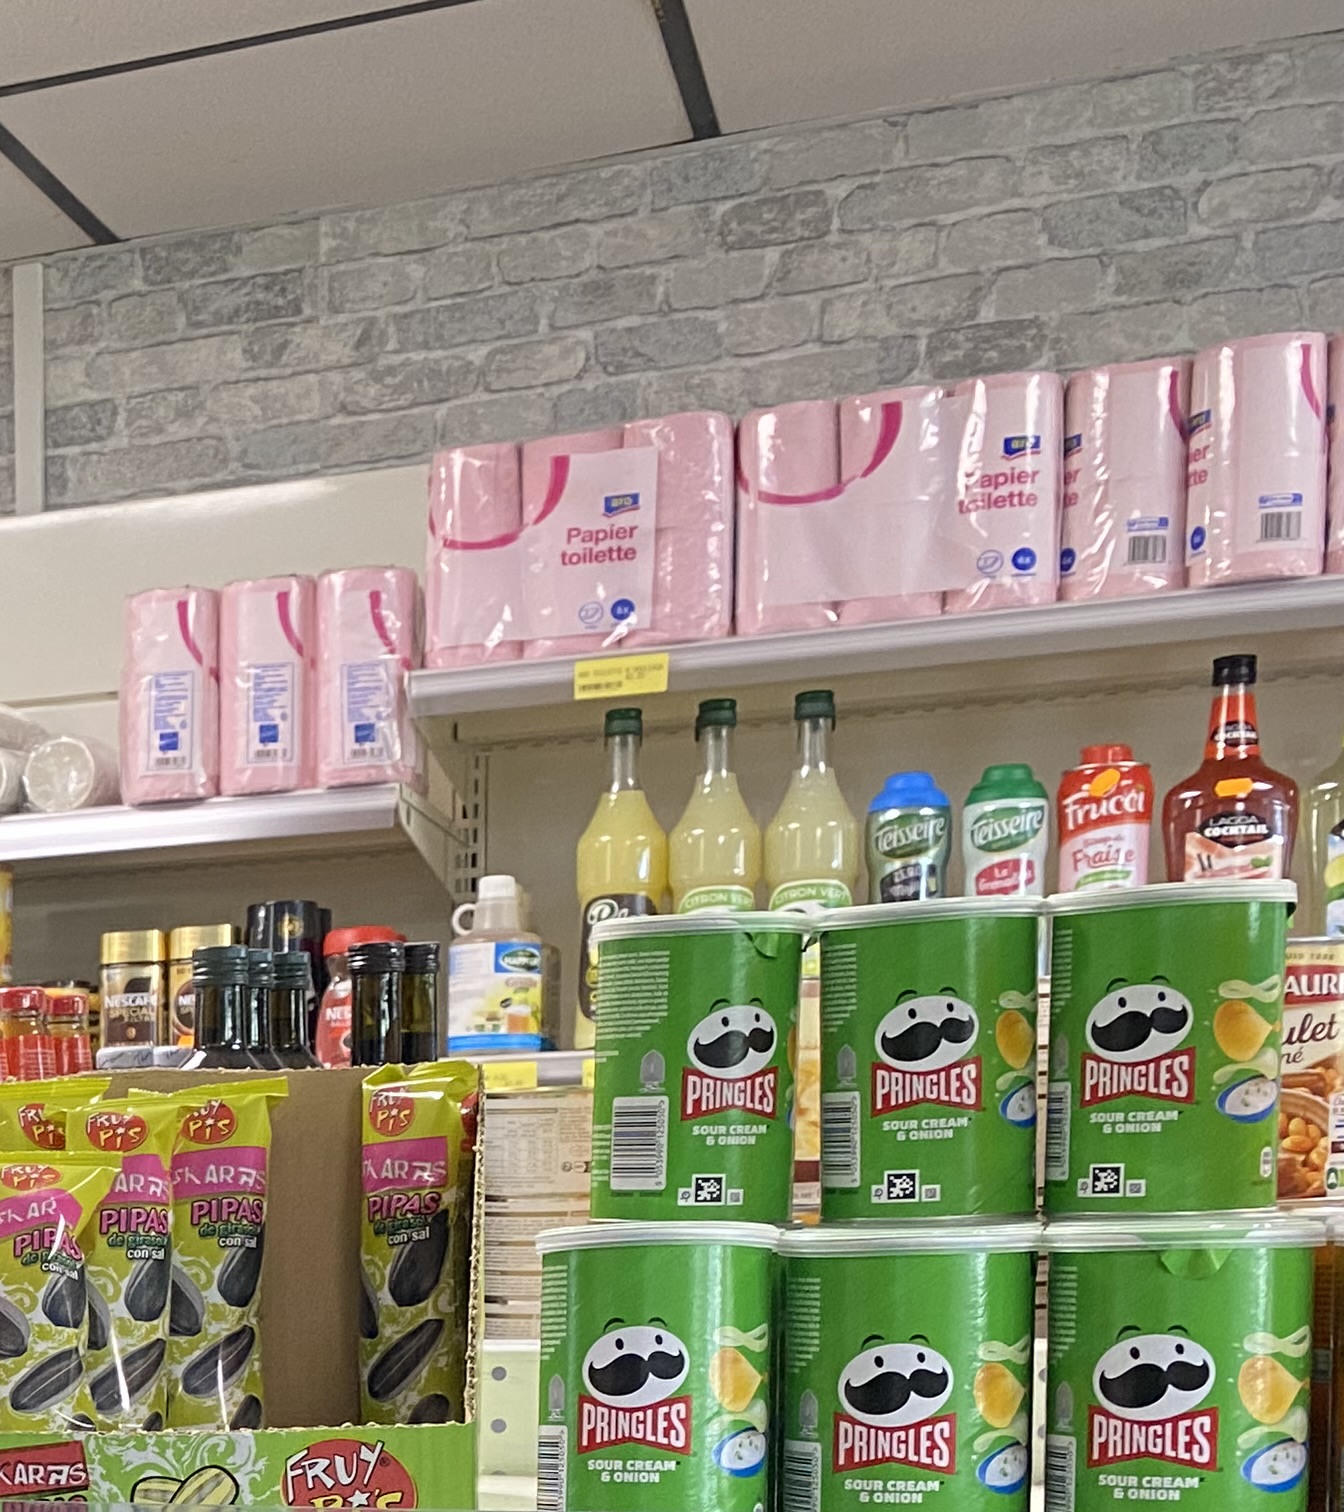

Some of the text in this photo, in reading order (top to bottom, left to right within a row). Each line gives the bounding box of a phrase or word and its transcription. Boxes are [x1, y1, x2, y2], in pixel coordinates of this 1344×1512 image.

[566, 524, 639, 545] Papier
[560, 544, 637, 565] toilette
[875, 815, 946, 852] Teisseire
[972, 807, 1044, 846] Teisseire
[1204, 824, 1268, 838] COCKTAIL
[685, 1073, 775, 1113] PRINGLES
[874, 1063, 975, 1110] PRINGLES
[1084, 1053, 1189, 1102] PRINGLES
[882, 1118, 968, 1133] SOUR CREAM
[909, 1127, 954, 1141] ONION
[127, 1248, 165, 1260] con sal
[581, 1400, 688, 1450] PRINGLES
[836, 1420, 952, 1470] PRINGLES
